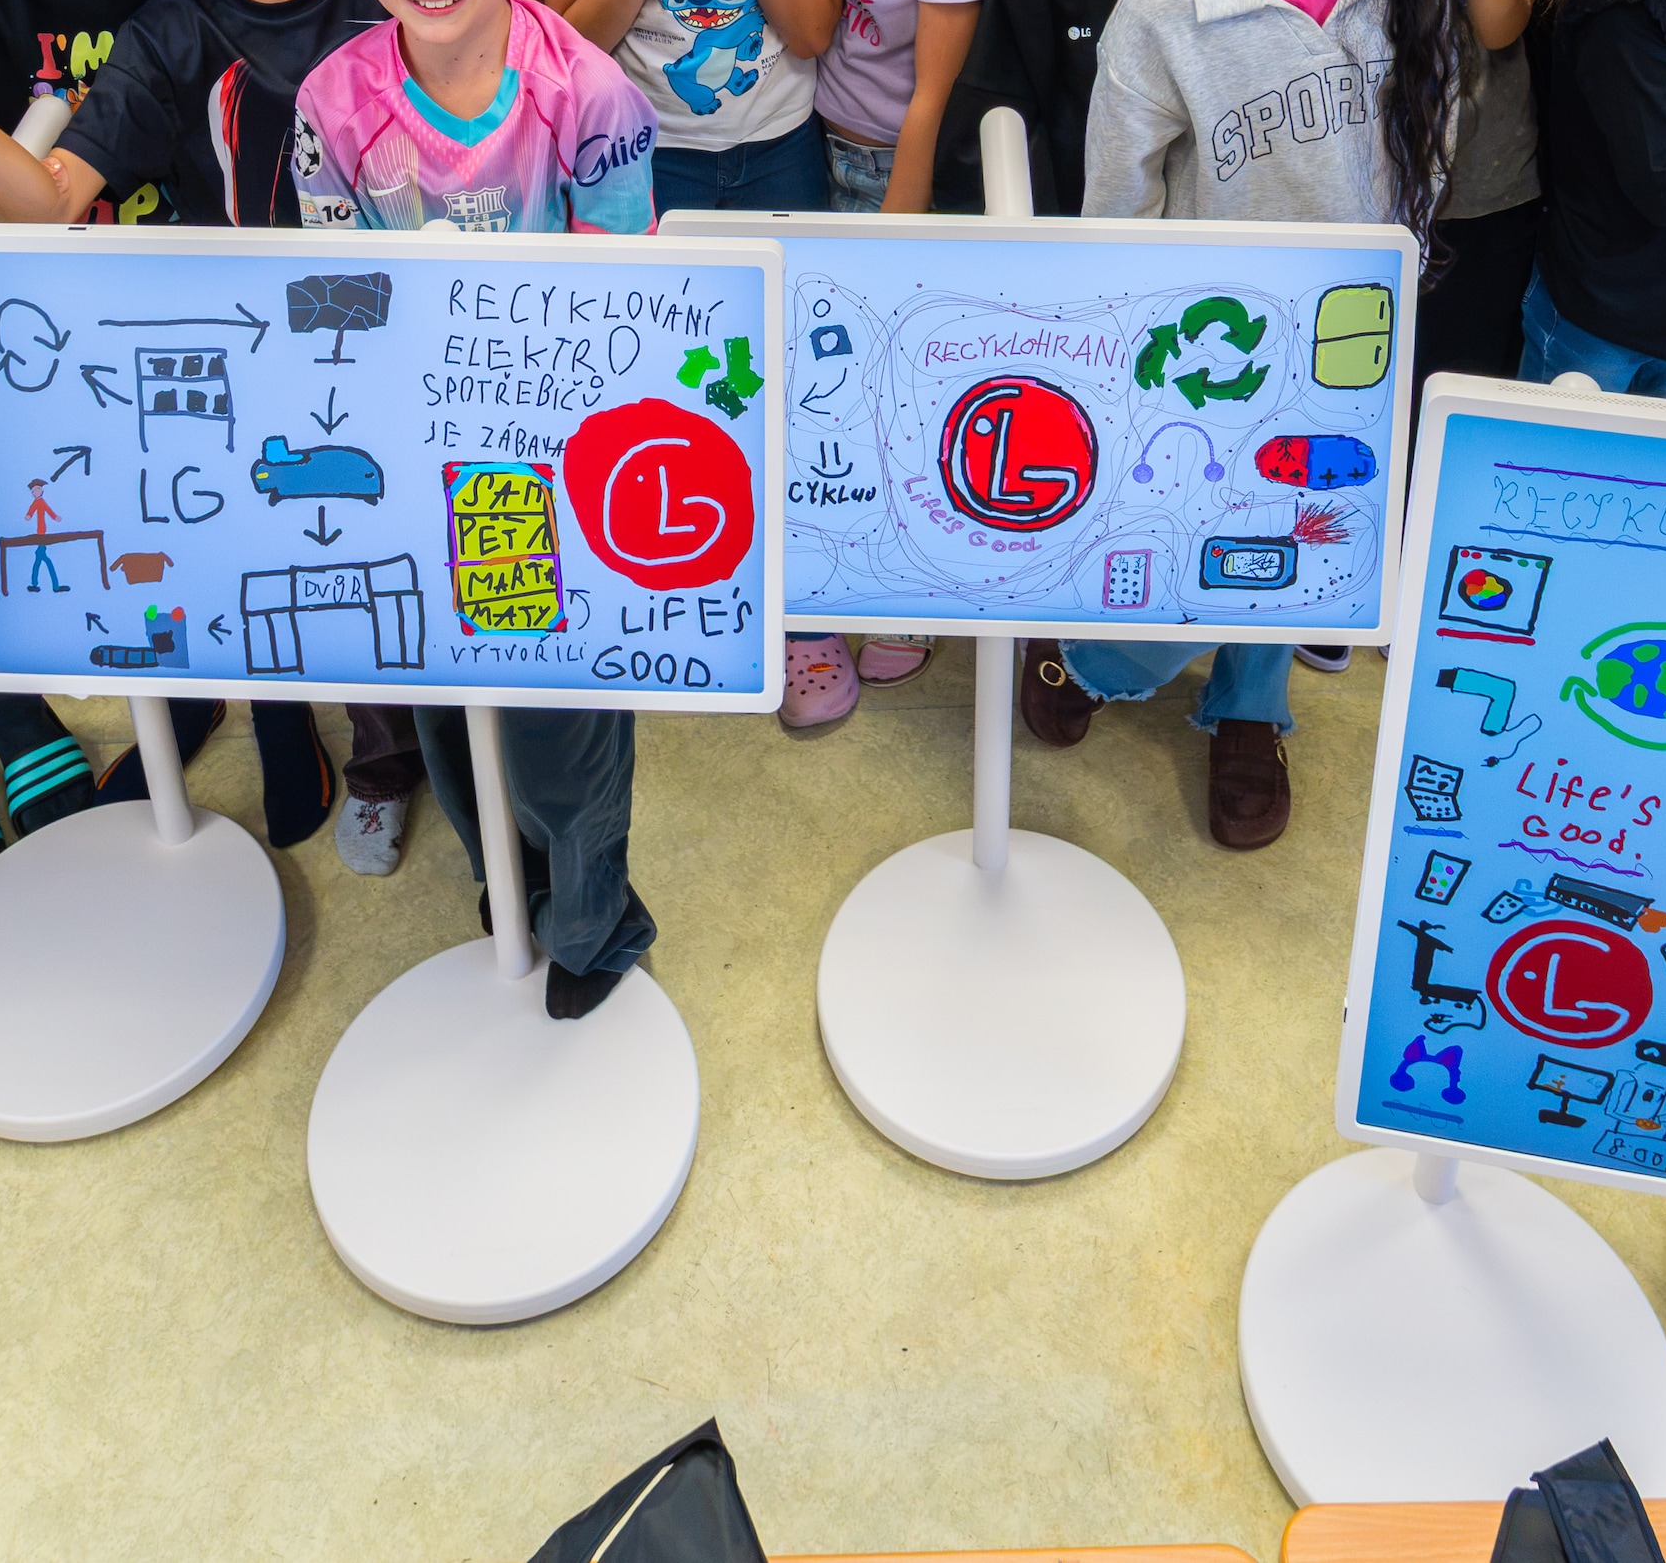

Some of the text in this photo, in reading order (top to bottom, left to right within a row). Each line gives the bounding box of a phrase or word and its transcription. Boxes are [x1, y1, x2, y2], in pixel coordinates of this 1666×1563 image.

[449, 277, 724, 337] RECYKLOVÁNÍ
[444, 325, 641, 376] ELEKTRO
[424, 421, 461, 448] JE
[139, 466, 224, 524] LG
[968, 530, 1043, 553] Good
[591, 653, 727, 689] GOOD.
[1515, 758, 1664, 826] Life's
[1521, 816, 1643, 861] Good.
